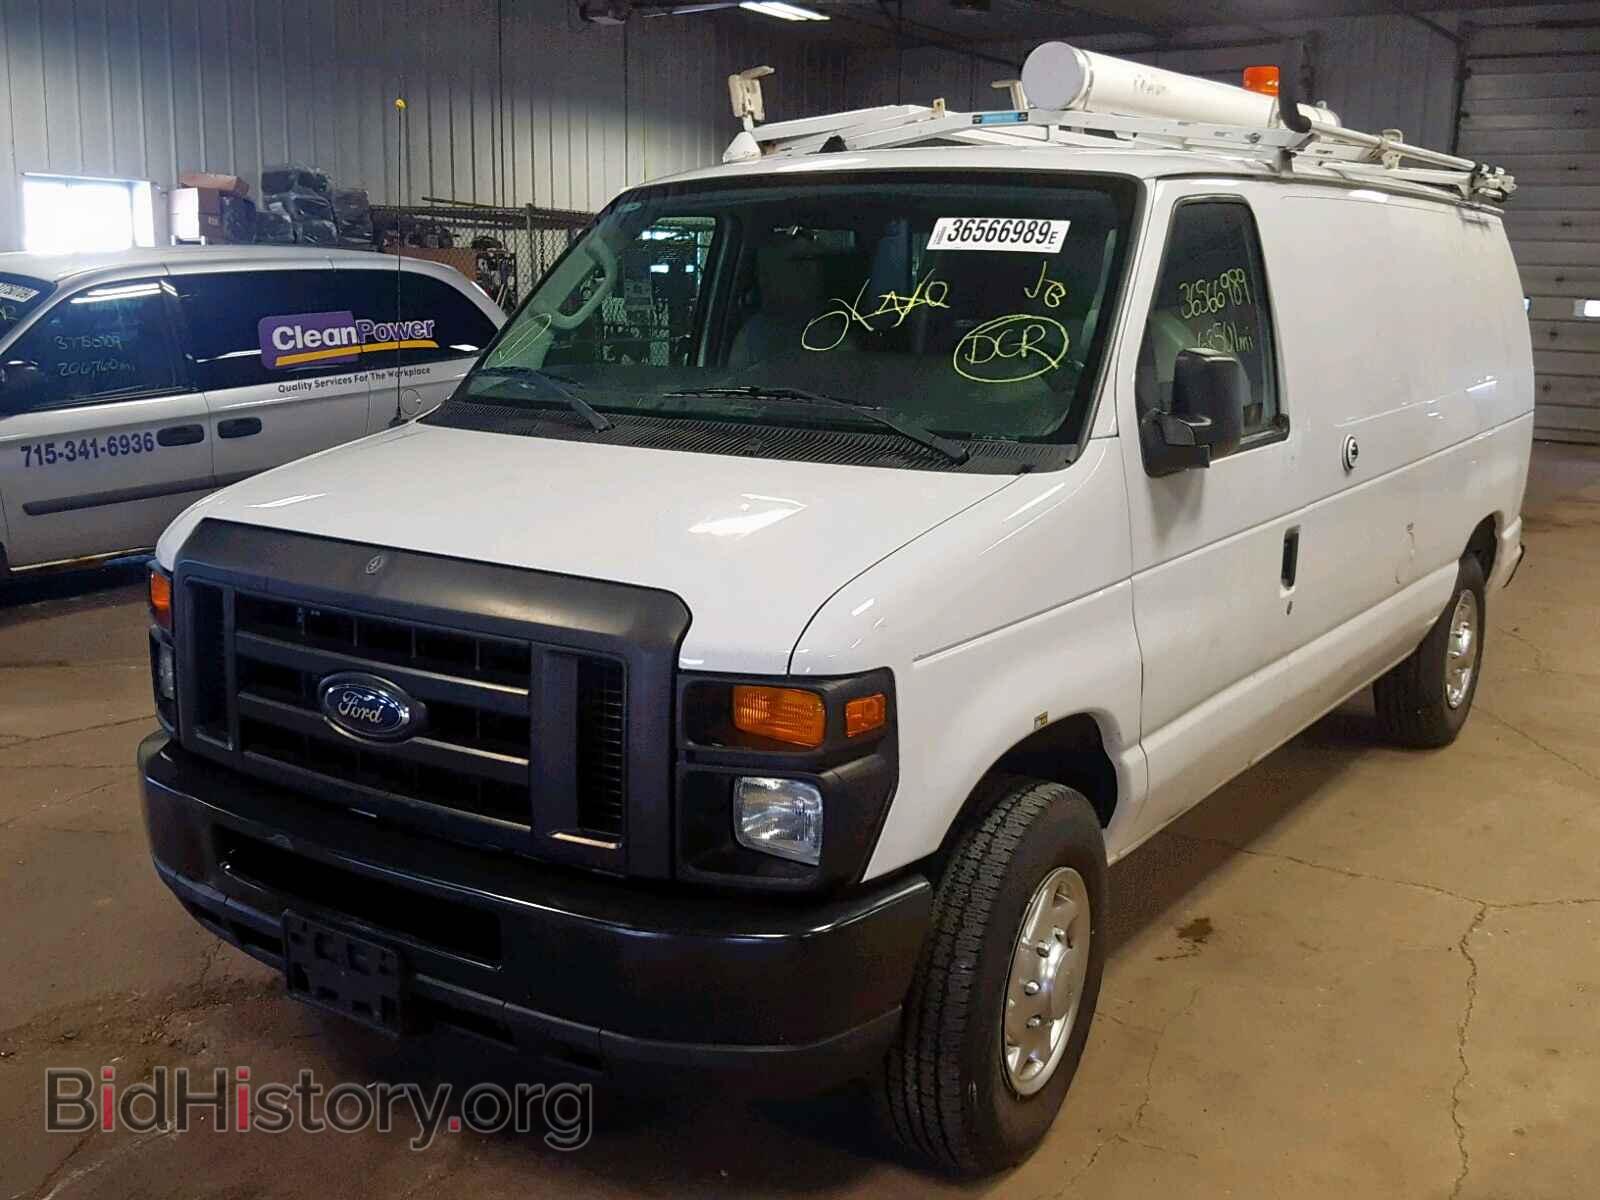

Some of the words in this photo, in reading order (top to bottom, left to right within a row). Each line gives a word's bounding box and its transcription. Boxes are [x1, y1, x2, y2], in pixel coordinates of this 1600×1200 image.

[278, 381, 313, 394] Quality
[314, 376, 353, 389] Services
[354, 373, 369, 383] For
[370, 370, 387, 381] The
[387, 367, 432, 378] Workplace
[20, 431, 155, 468] 715-341-6936
[338, 691, 385, 724] Ford
